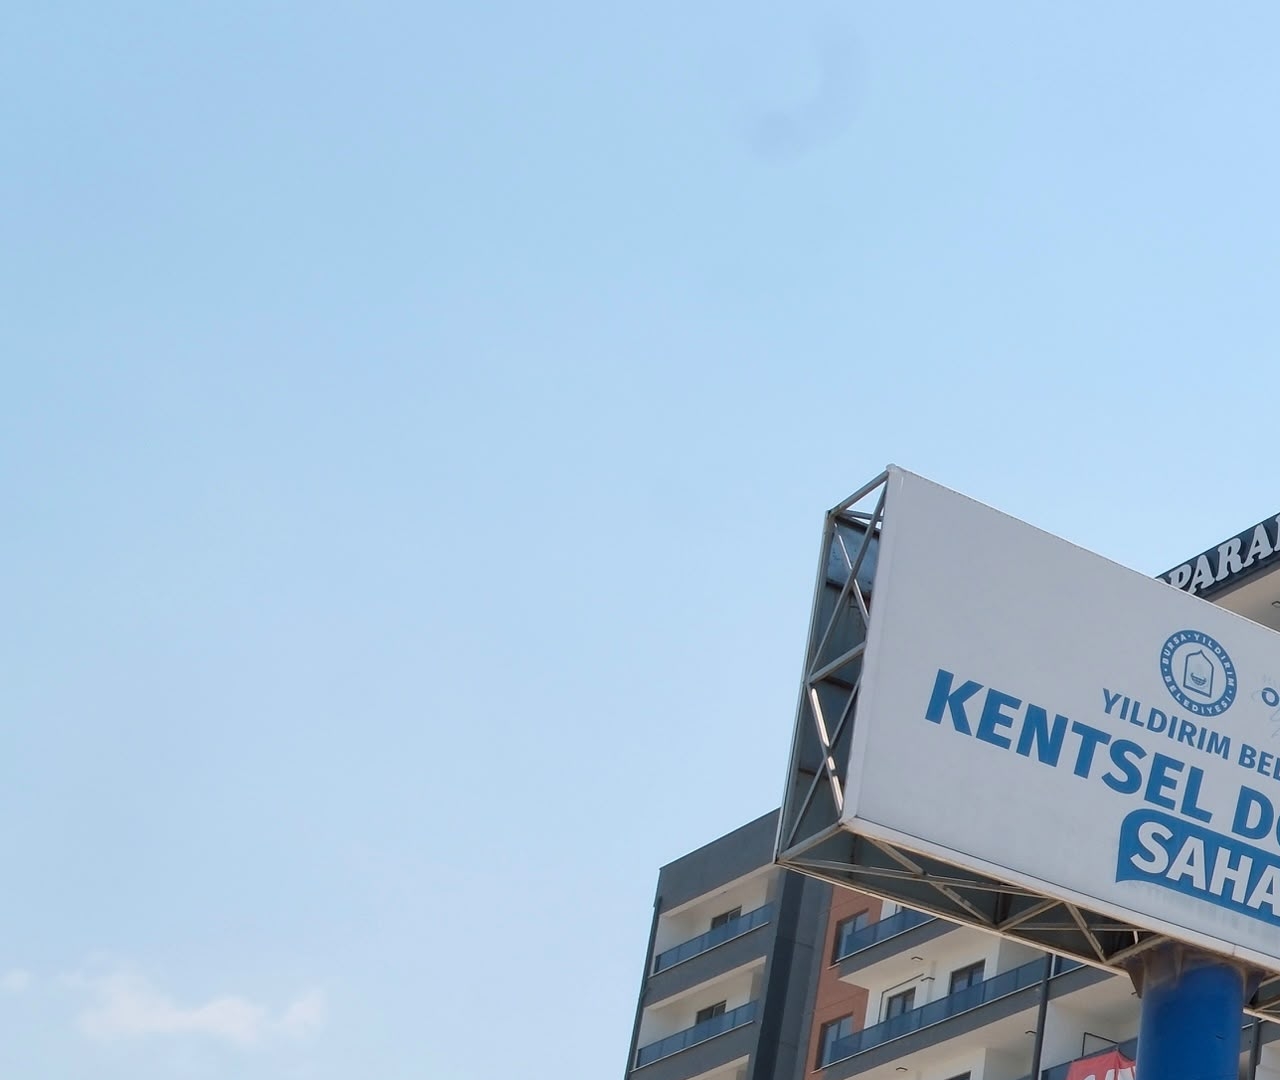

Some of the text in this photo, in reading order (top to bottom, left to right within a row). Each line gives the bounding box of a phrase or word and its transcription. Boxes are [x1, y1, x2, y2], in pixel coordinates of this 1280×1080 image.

[1162, 633, 1235, 687] BURSA YILDIRIM
[924, 668, 1217, 824] KENTSEL
[1103, 687, 1233, 760] YILDIRIM
